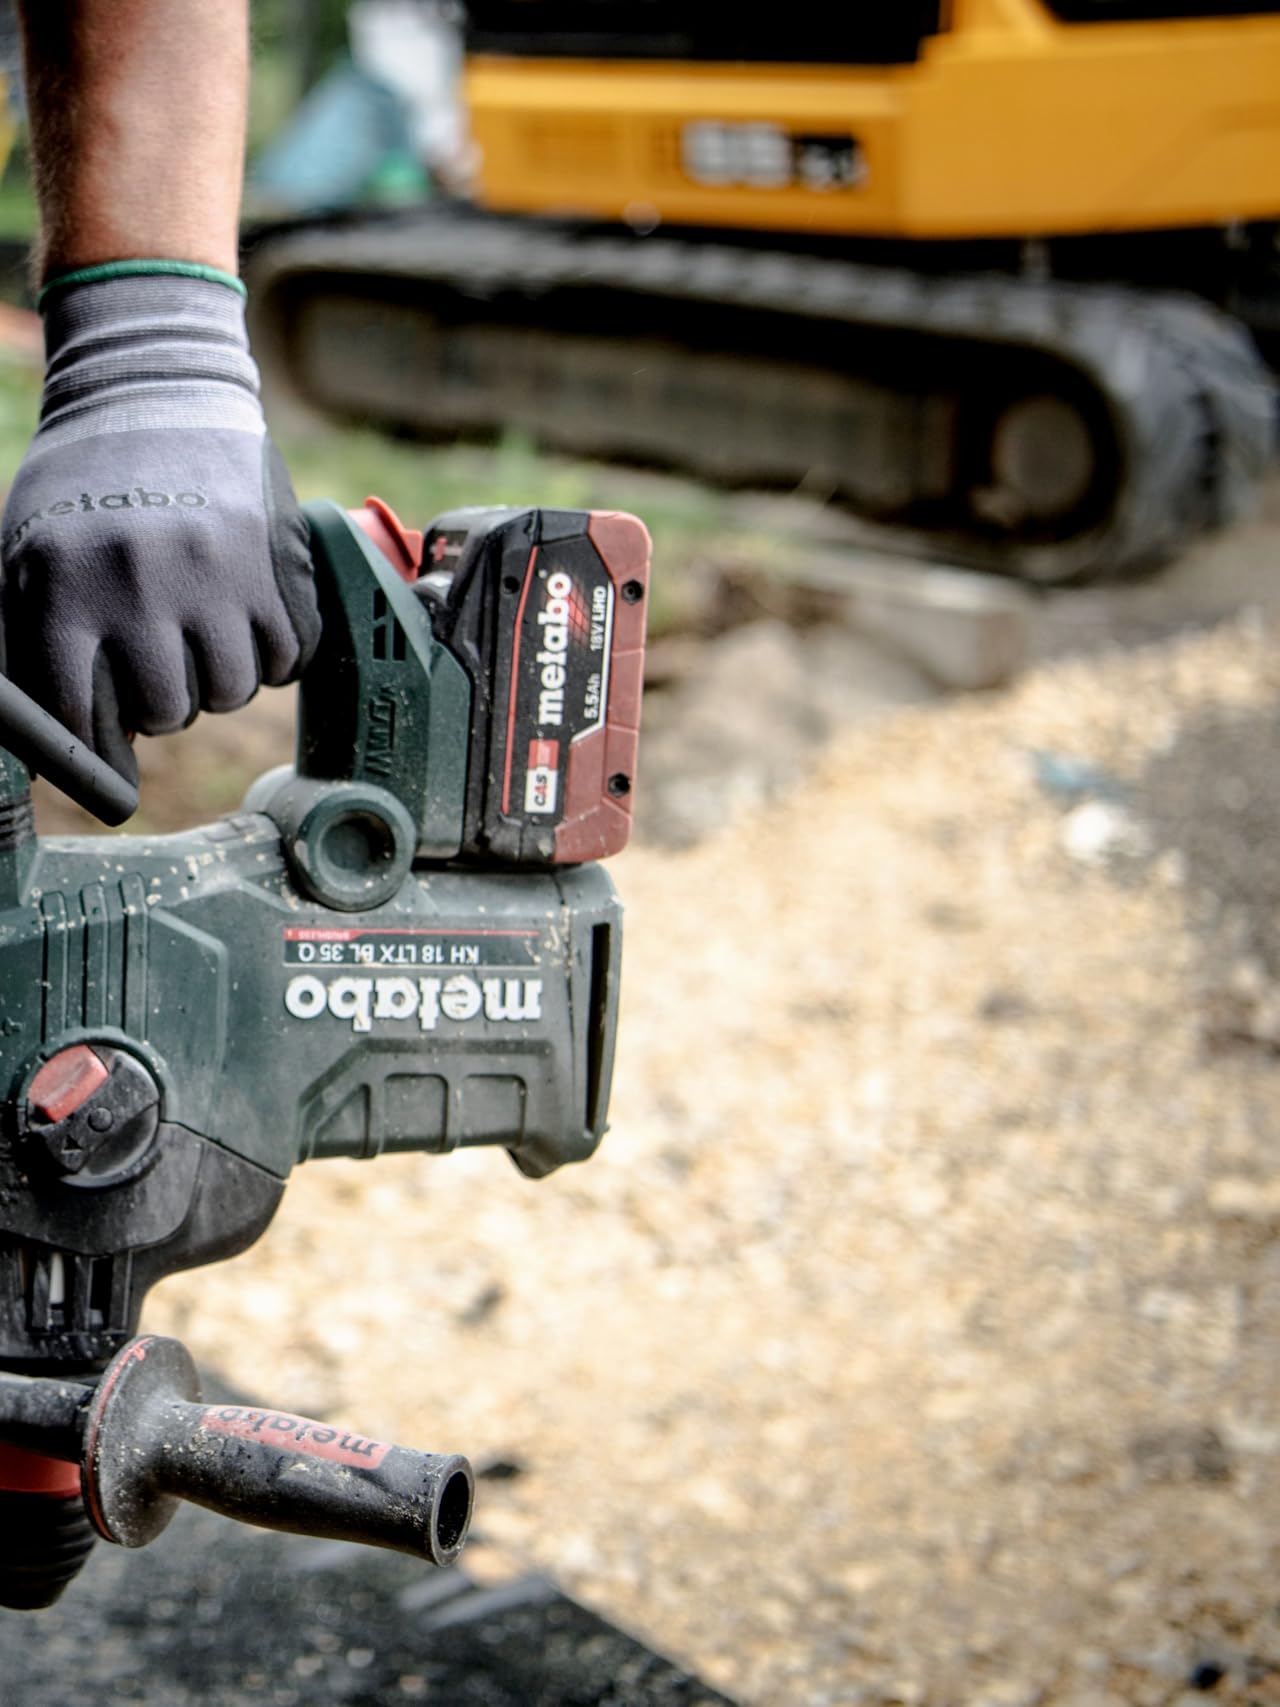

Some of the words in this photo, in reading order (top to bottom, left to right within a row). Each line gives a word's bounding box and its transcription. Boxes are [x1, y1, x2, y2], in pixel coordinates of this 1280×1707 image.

[590, 621, 604, 651] 18V
[537, 572, 572, 725] metabo
[533, 774, 547, 807] CAS
[298, 943, 314, 961] Q
[320, 943, 344, 961] 35
[350, 944, 375, 962] BL
[380, 944, 416, 962] LTX
[422, 945, 443, 962] 18
[451, 946, 479, 963] KH
[285, 974, 543, 1032] metabo
[220, 1407, 379, 1457] metabo
